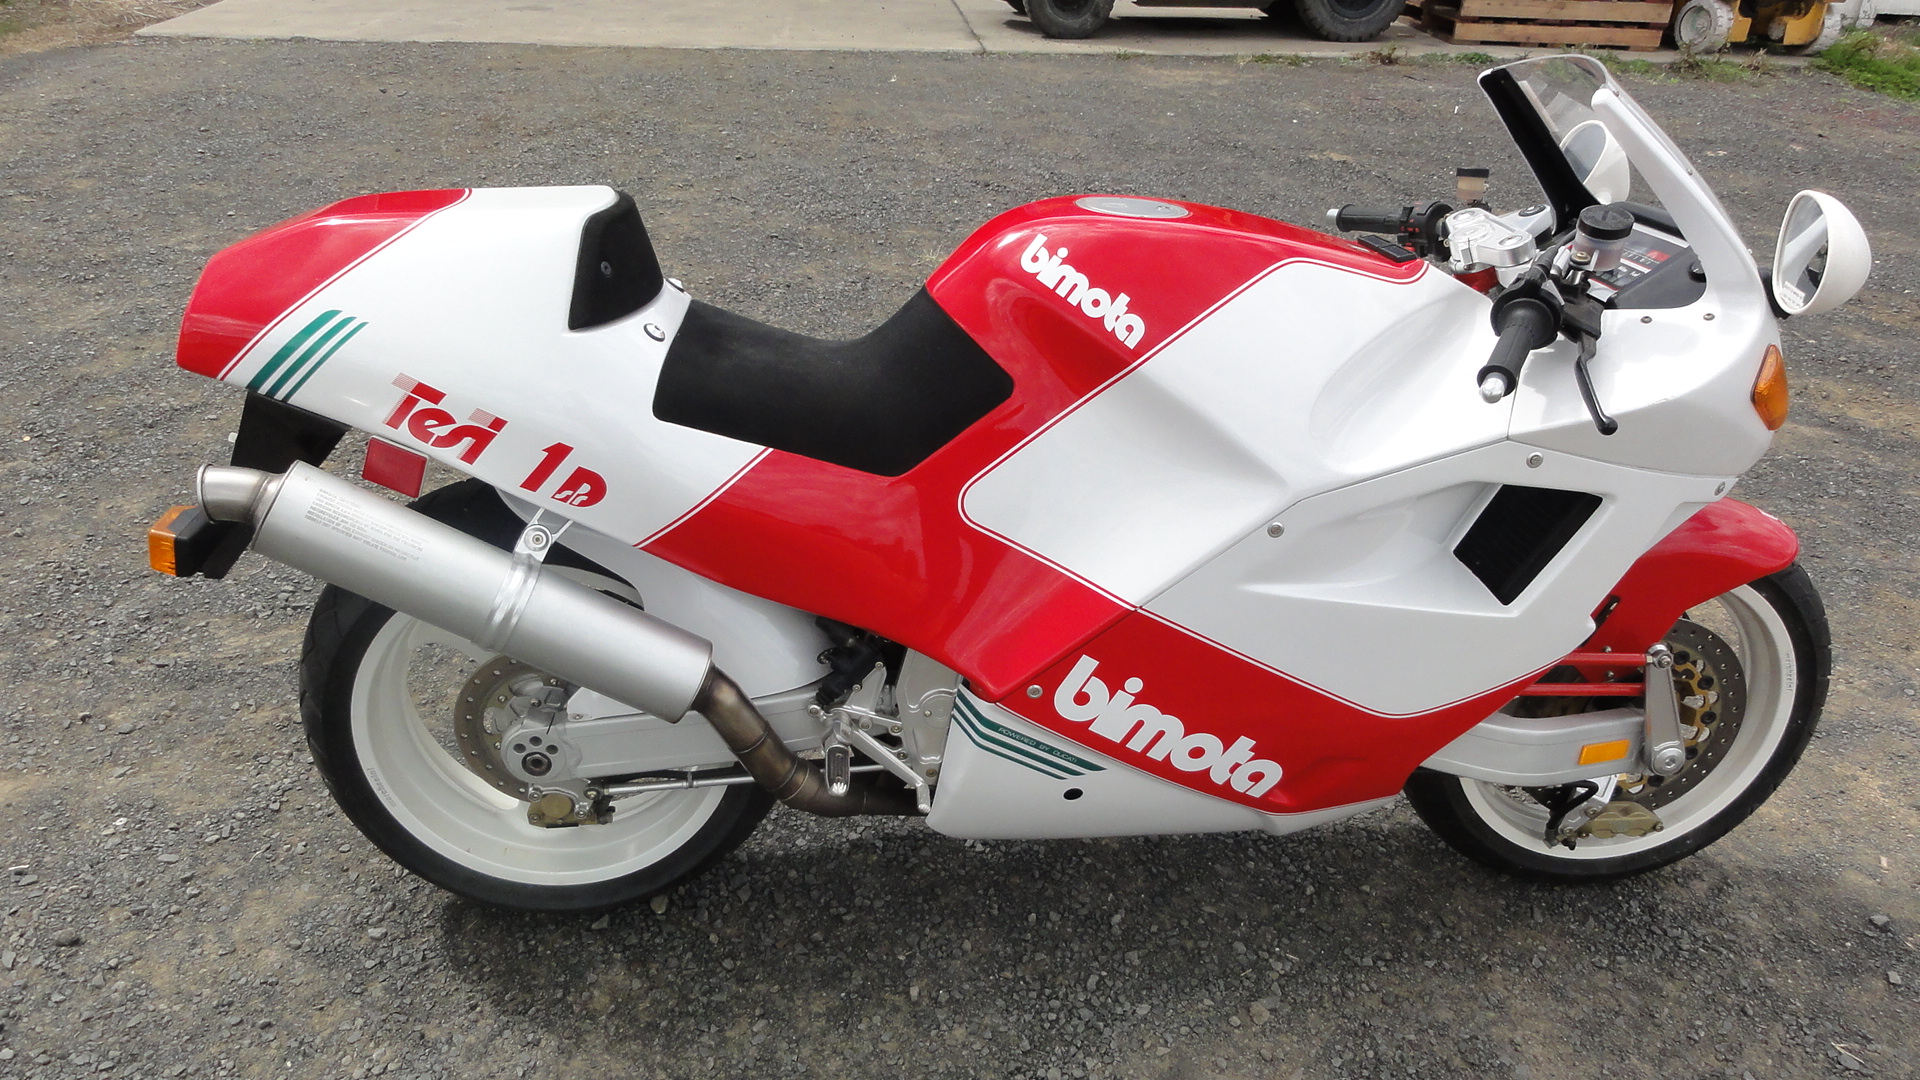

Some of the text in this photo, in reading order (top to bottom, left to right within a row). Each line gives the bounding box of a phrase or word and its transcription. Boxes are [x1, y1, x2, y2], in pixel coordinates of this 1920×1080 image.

[1020, 233, 1146, 350] bimota
[382, 372, 509, 466] Tesi
[998, 727, 1036, 746] POWERED
[1052, 750, 1078, 763] DUCATI
[1054, 654, 1283, 798] bimota
